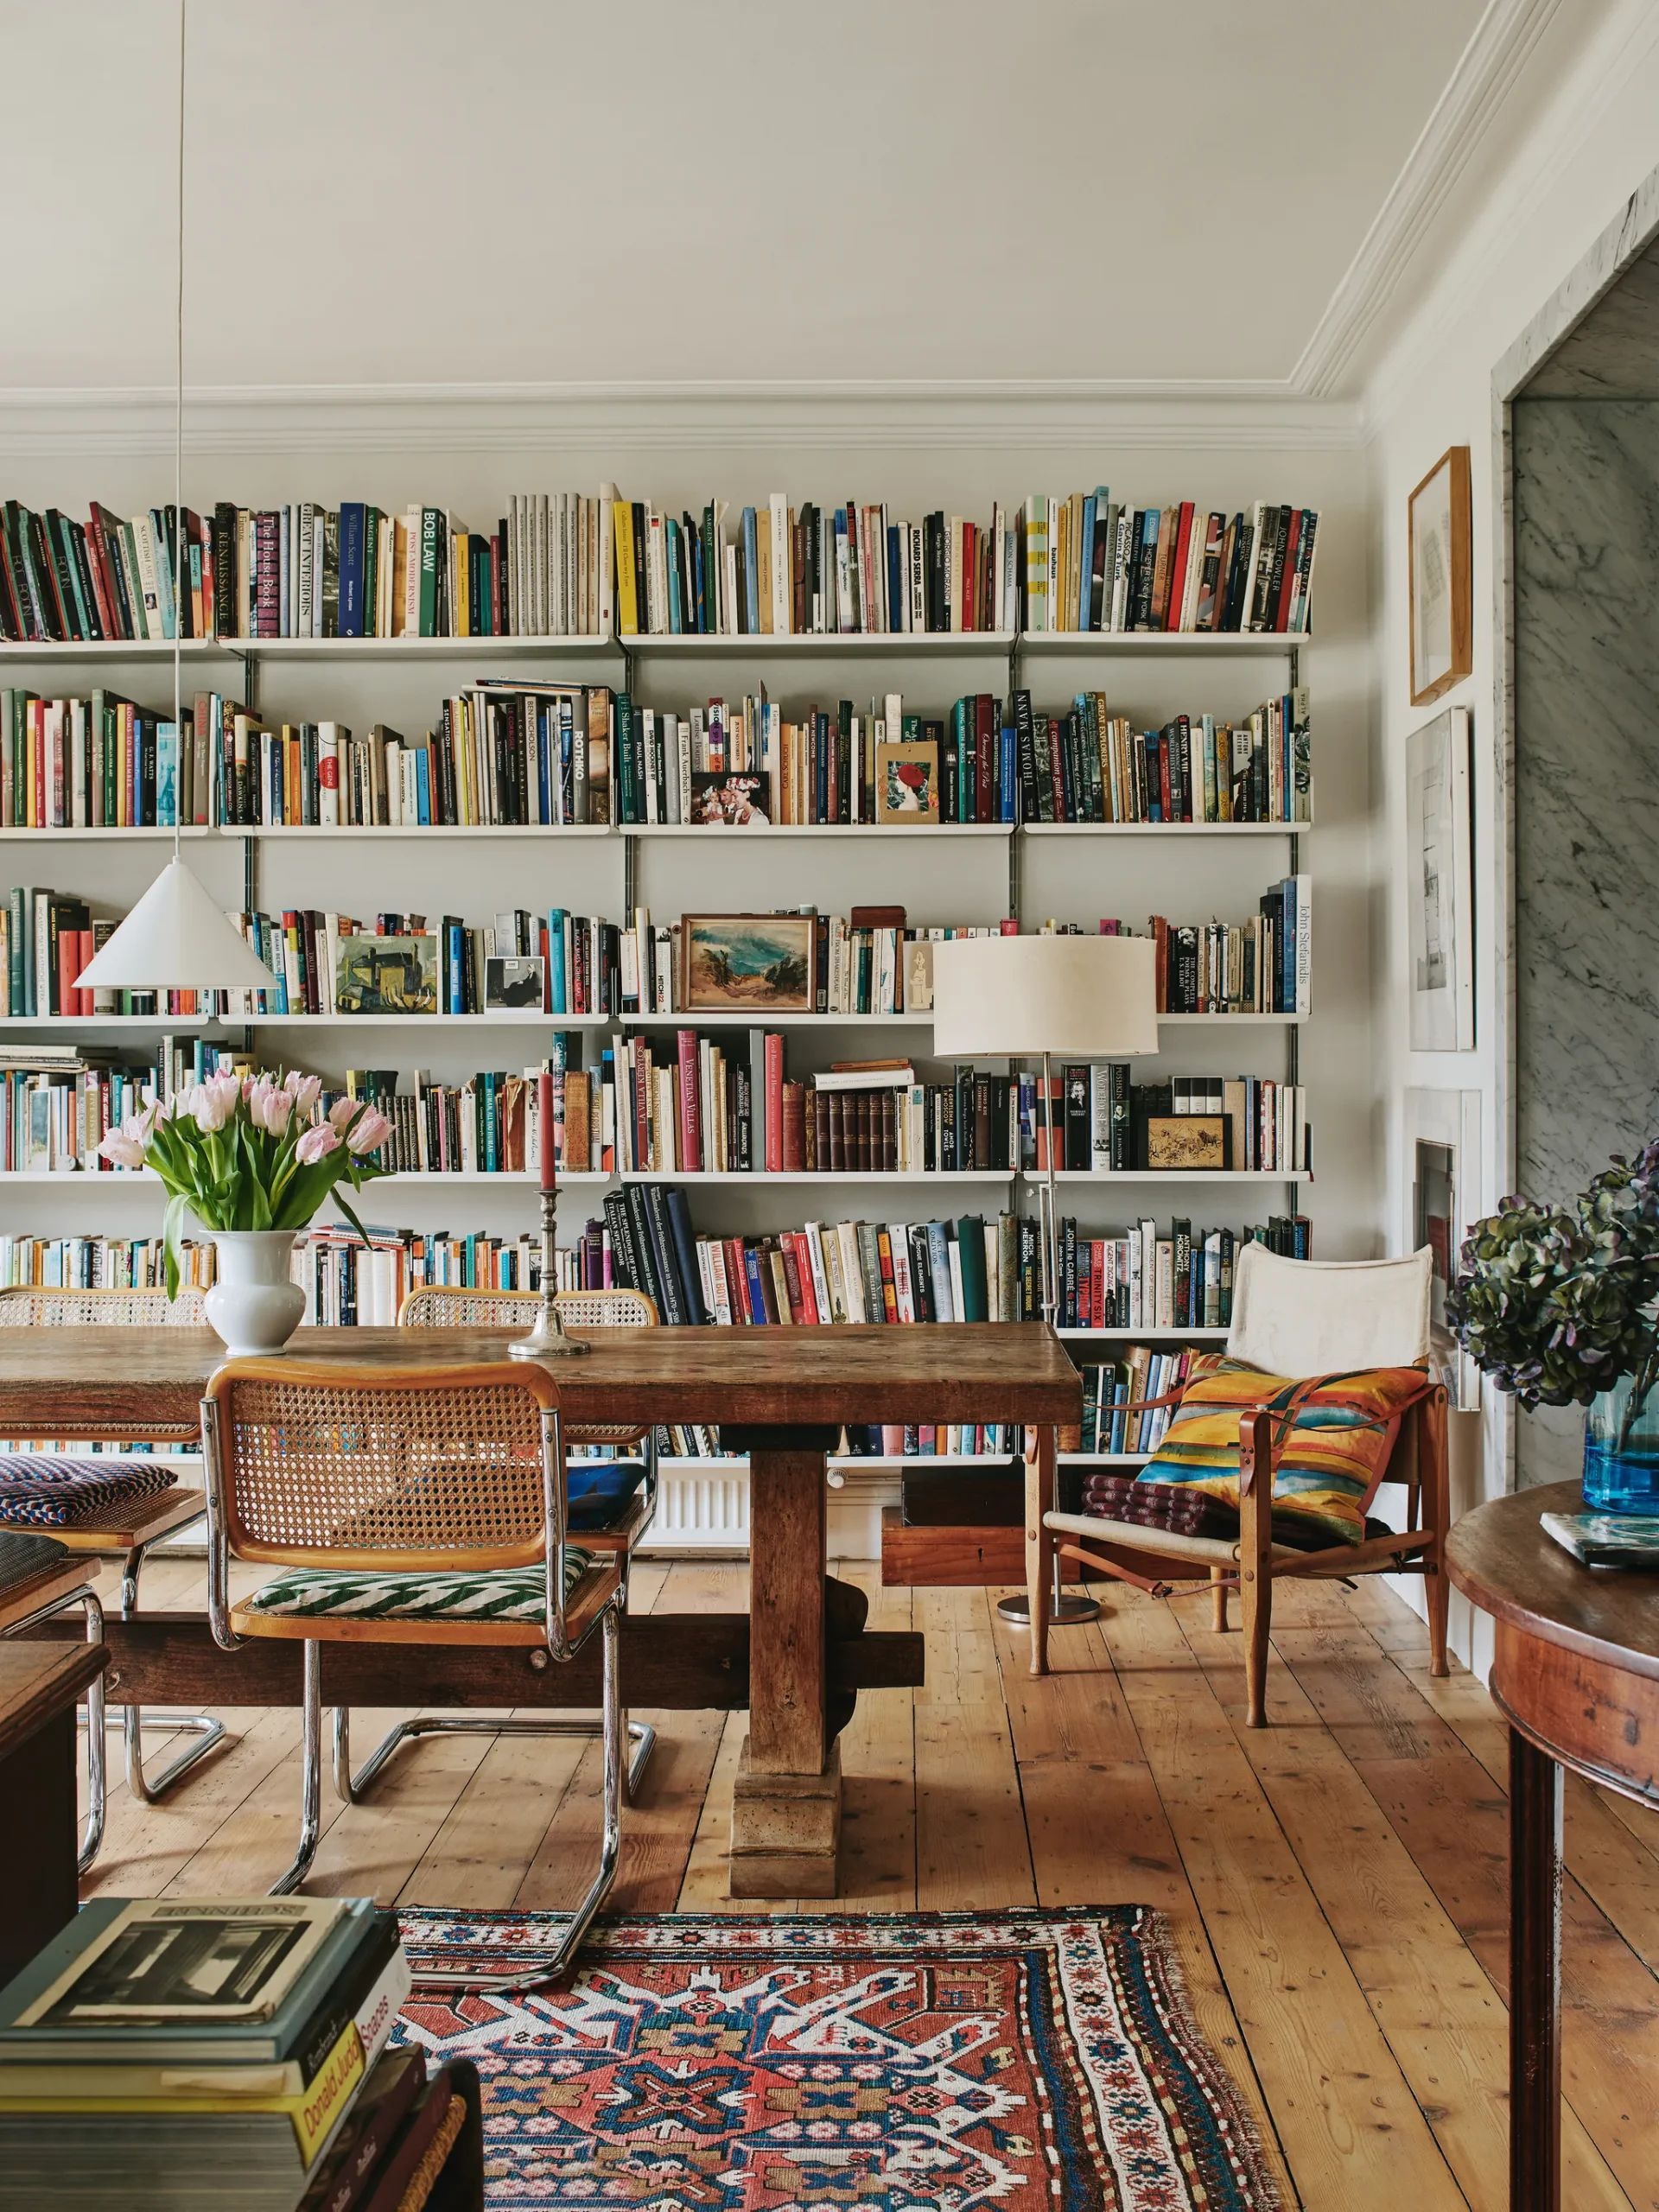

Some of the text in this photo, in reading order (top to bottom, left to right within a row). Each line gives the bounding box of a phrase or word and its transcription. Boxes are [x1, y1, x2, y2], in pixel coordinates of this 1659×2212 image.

[94, 524, 105, 557] RAEBURN
[141, 525, 153, 578] SCOTTISH ART
[263, 518, 275, 607] The House Book
[302, 504, 311, 615] GREAT INTERIORS
[423, 512, 435, 571] BOB LAW
[1143, 549, 1153, 582] HOPPER'S
[1273, 526, 1287, 591] JOHN FOWLER
[1301, 516, 1316, 592] LITTLE SPARTA
[57, 556, 72, 589] RODIN
[219, 532, 229, 620] RENAISSANCE
[408, 532, 416, 614] POST-MODERNISM
[127, 736, 131, 745] TO
[198, 700, 207, 736] CHINA
[621, 712, 632, 762] Shaker Built
[1017, 695, 1033, 788] THOMAS MANN
[575, 731, 584, 780] ROTHKO
[1051, 731, 1064, 798] companion guide
[1099, 726, 1108, 767] EXPLORERS
[1300, 905, 1309, 984] John Stefanidis
[687, 1103, 696, 1134] VILLAS
[1096, 1070, 1107, 1125] WODEHOUSE
[630, 1188, 642, 1221] Wandmalerei
[635, 1222, 644, 1230] der
[608, 1202, 625, 1266] ITALIAN SPLENDOR
[638, 1231, 651, 1272] Frührenaissance
[651, 1188, 661, 1221] Wandmalerei
[658, 1231, 671, 1272] Frührenaissance
[667, 1280, 676, 1296] Italien
[930, 1230, 938, 1264] OBLIVION
[1149, 1239, 1154, 1249] AN
[647, 1279, 656, 1294] Italien
[711, 1244, 726, 1304] WILLIAM BOYD
[897, 1257, 909, 1295] THE KNIVES
[1078, 1277, 1090, 1318] TYPHOON
[1149, 1274, 1154, 1283] OF
[359, 1994, 390, 2051] Spaces
[303, 2067, 339, 2139] Donald
[336, 2031, 359, 2086] Judd
